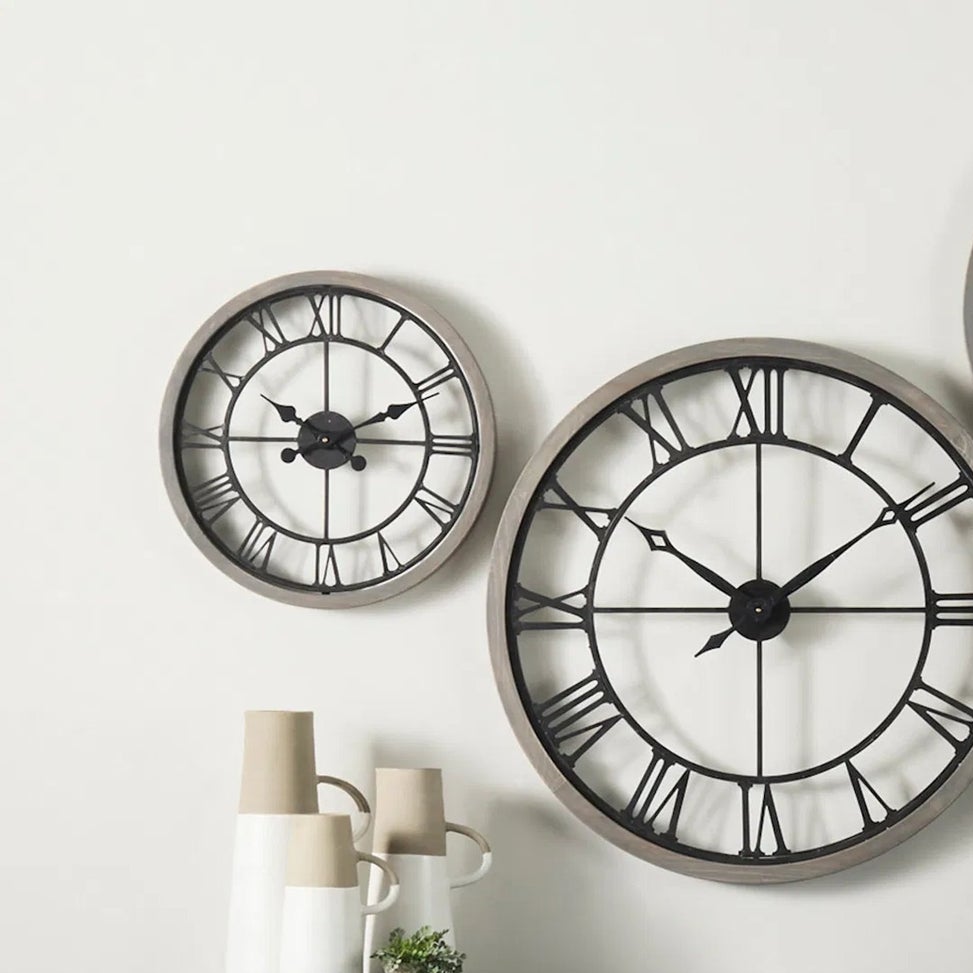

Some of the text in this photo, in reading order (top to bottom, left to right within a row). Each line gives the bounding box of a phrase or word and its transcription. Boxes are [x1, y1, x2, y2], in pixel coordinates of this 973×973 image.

[246, 302, 291, 356] XI
[307, 291, 345, 339] XII
[198, 351, 246, 395] X
[412, 358, 462, 396] II
[615, 382, 695, 471] XI
[723, 363, 789, 441] XII
[428, 434, 476, 459] III
[535, 472, 618, 542] X
[313, 541, 345, 589] VI
[377, 529, 406, 576] V
[511, 582, 593, 637] IX
[737, 781, 791, 858] VI
[845, 759, 899, 832] V
